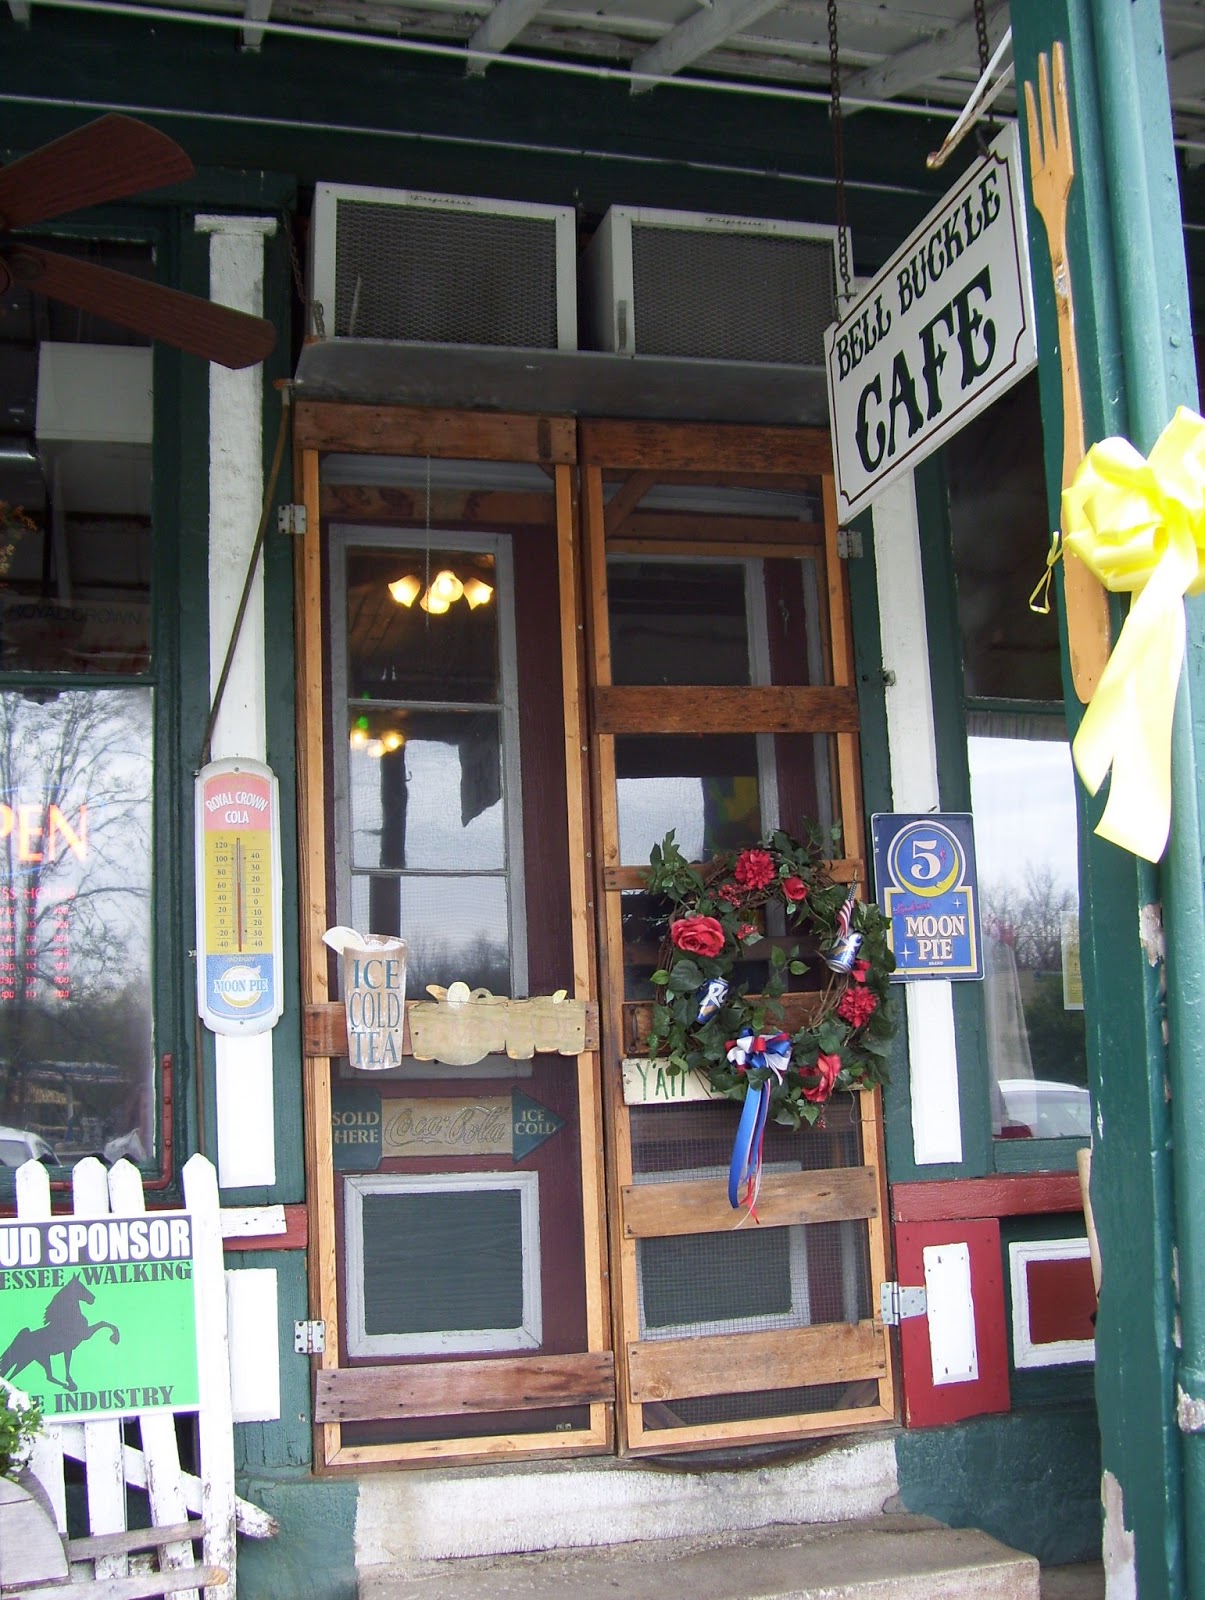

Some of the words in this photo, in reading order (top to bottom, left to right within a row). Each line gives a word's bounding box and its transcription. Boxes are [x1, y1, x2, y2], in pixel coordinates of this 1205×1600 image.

[836, 293, 892, 382] BELL
[897, 168, 1000, 316] BUCKLE
[854, 264, 997, 473] CAFE
[205, 791, 234, 812] ROYAL
[235, 791, 269, 812] CROWN
[224, 810, 250, 824] COLA
[905, 915, 966, 937] MOON
[916, 938, 954, 960] PIE
[353, 959, 400, 990] ICE
[214, 980, 247, 993] MOON
[249, 979, 268, 992] PIE
[349, 992, 400, 1029] COLD
[350, 1031, 399, 1064] TEA
[331, 1110, 380, 1126] SOLD
[522, 1109, 545, 1122] ICE
[334, 1129, 379, 1144] HERE
[514, 1122, 557, 1135] COLD
[48, 1219, 191, 1265] SPONSOR
[81, 1261, 192, 1286] WALKING
[54, 1386, 174, 1414] INDUSTRY
